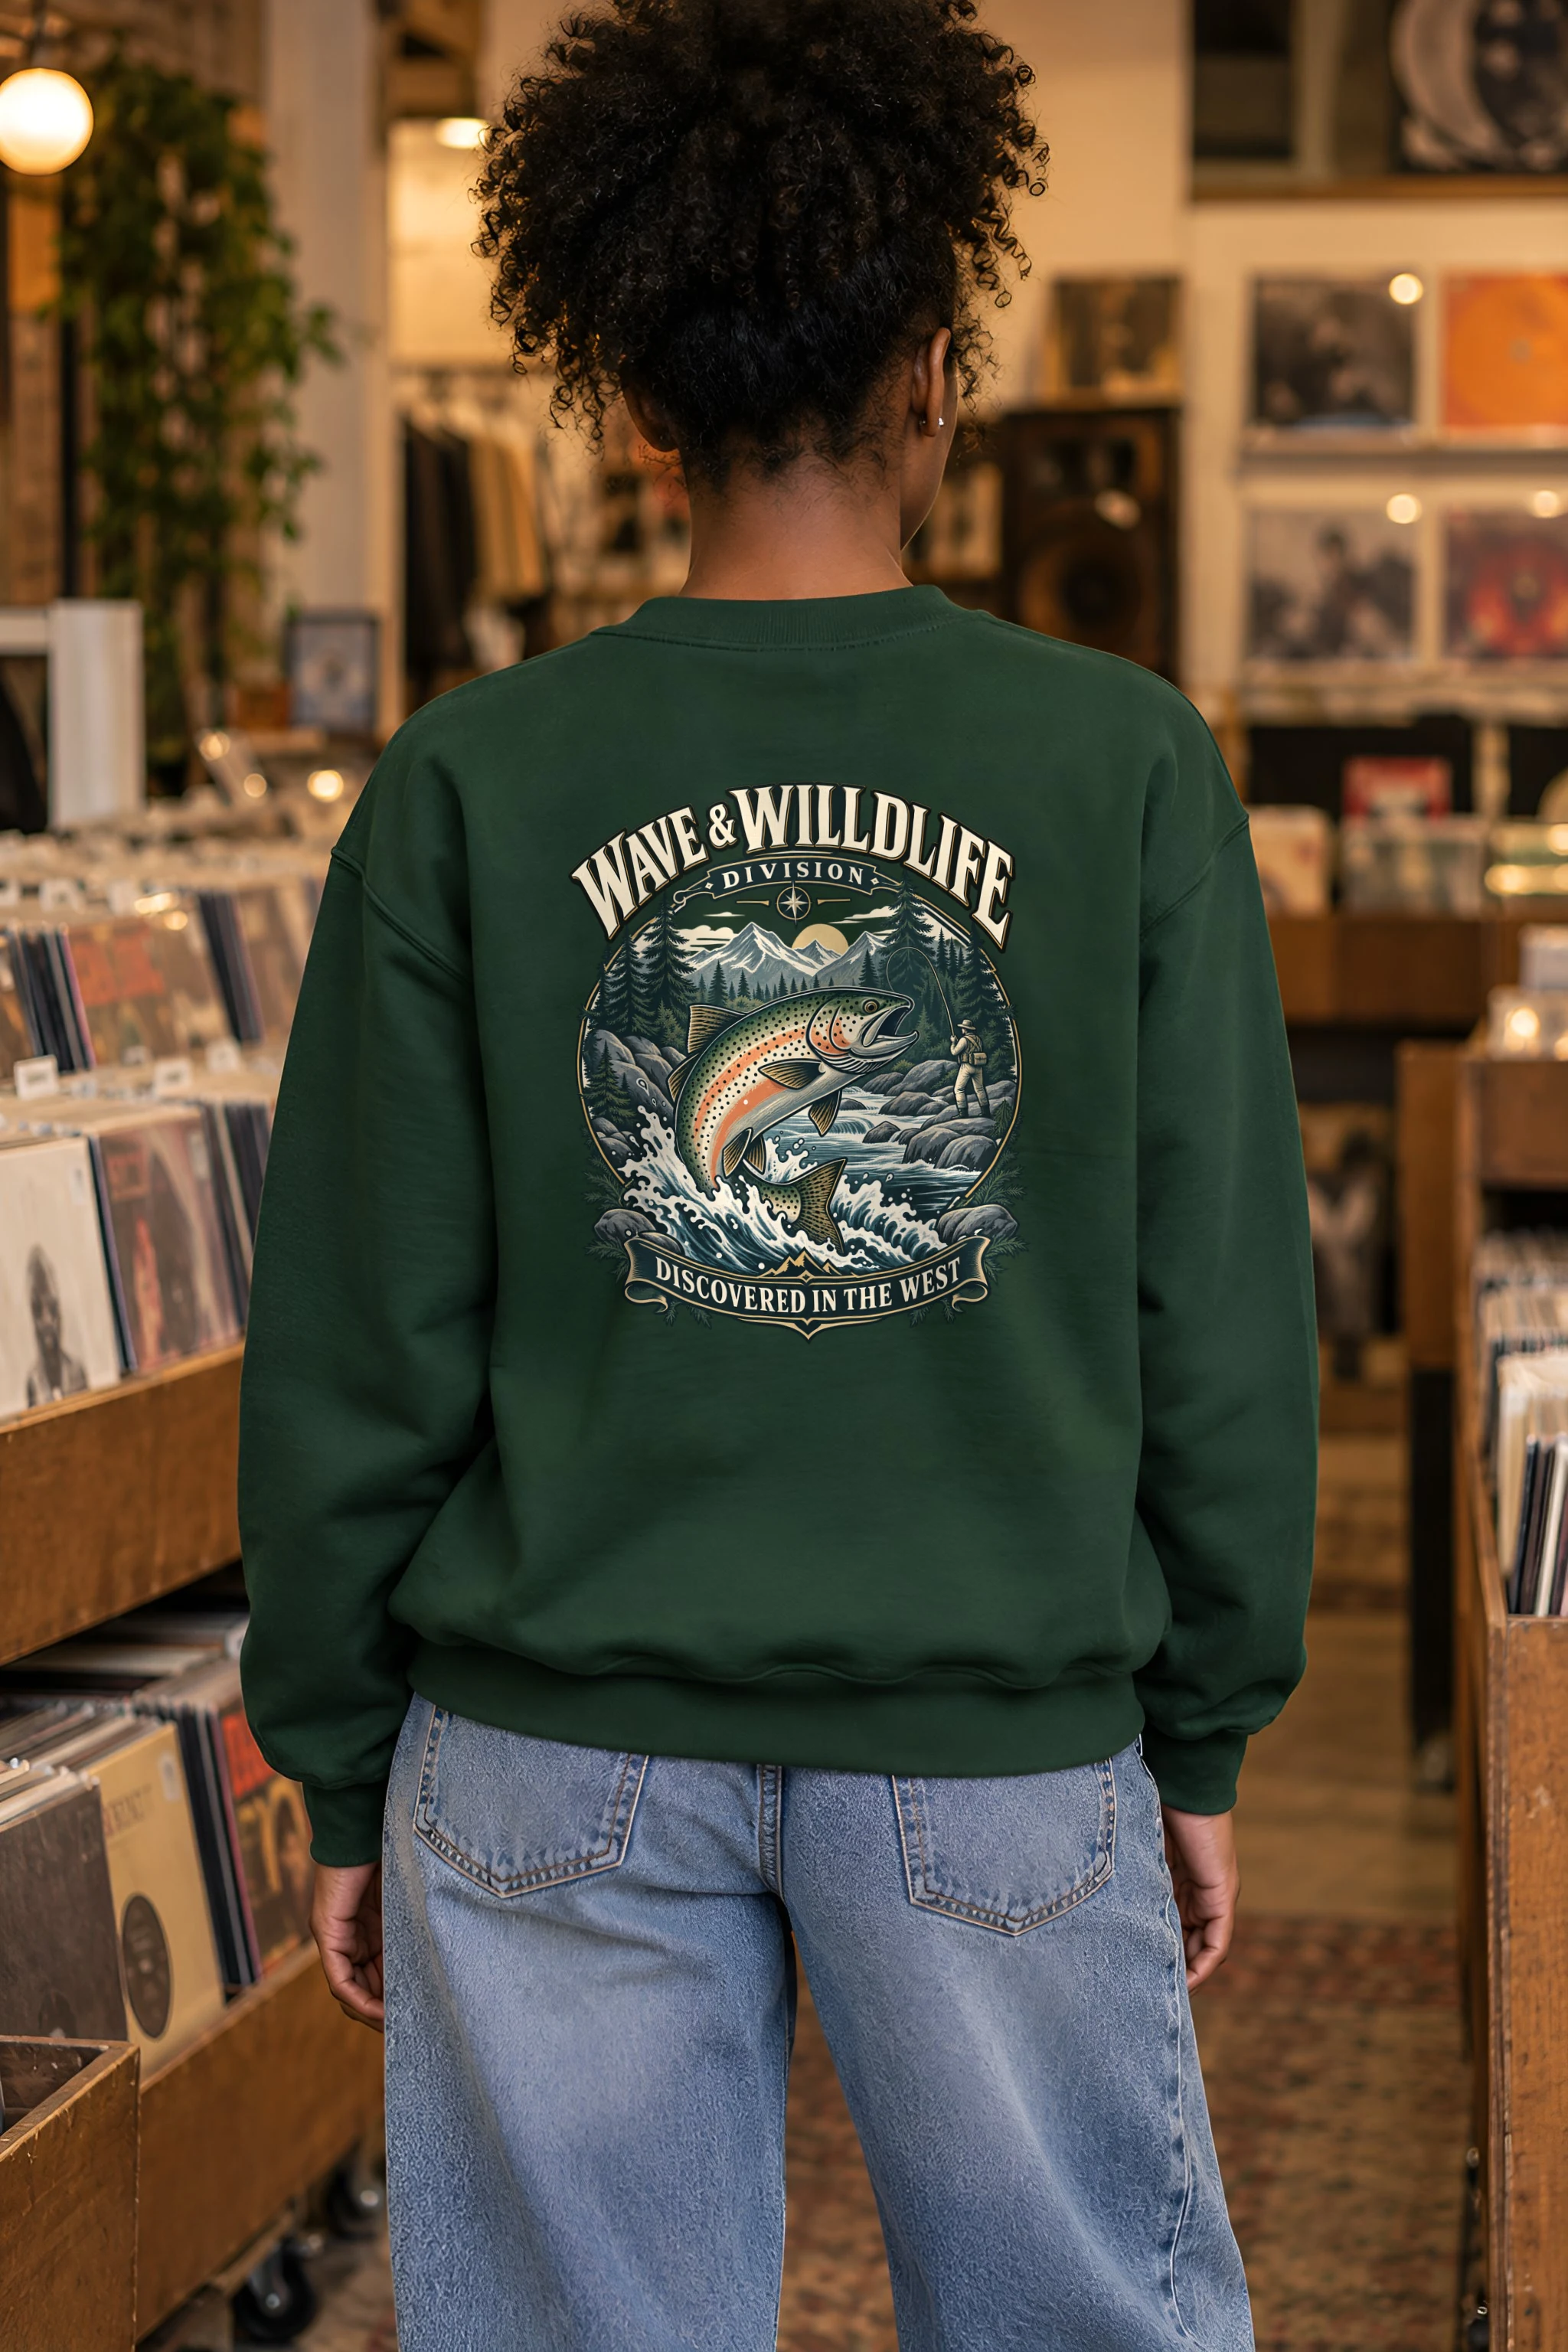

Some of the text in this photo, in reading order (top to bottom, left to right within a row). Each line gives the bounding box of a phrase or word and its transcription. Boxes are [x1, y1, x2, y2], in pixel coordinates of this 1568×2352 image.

[571, 784, 1013, 949] WAVE & WILLDLIFE
[721, 861, 864, 890] DIVISION
[655, 1256, 961, 1314] DISCOVERED IN THE WEST
